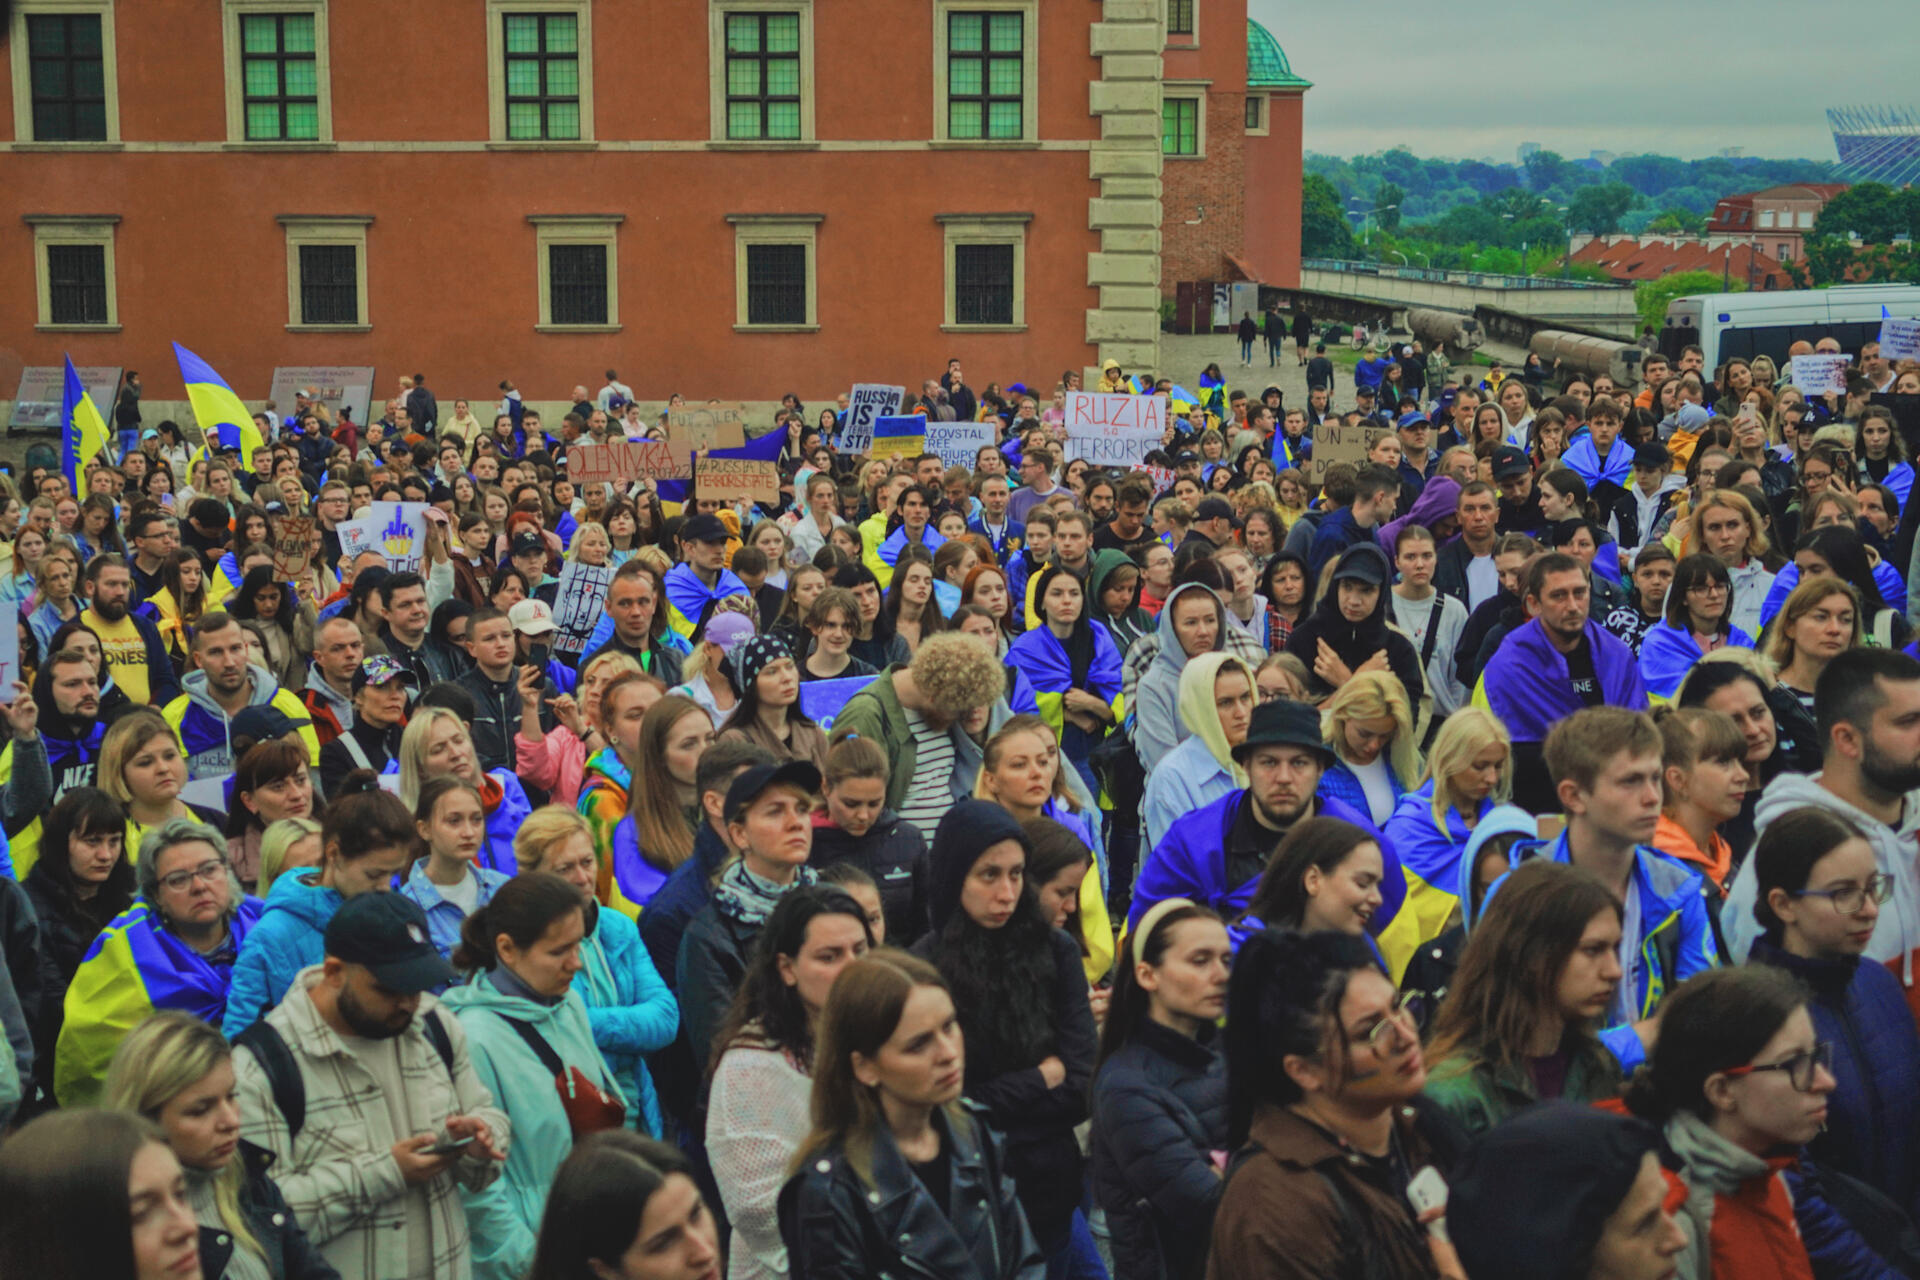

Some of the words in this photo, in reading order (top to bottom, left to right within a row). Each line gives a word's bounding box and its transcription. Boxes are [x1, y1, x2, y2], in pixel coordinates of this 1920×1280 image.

[854, 390, 900, 406] RUSSIA
[852, 405, 873, 425] IS
[1075, 395, 1157, 430] RUZIA
[844, 434, 871, 449] STA
[566, 442, 675, 479] OLENIVKA
[102, 650, 145, 665] ONES
[1572, 680, 1592, 693] INE
